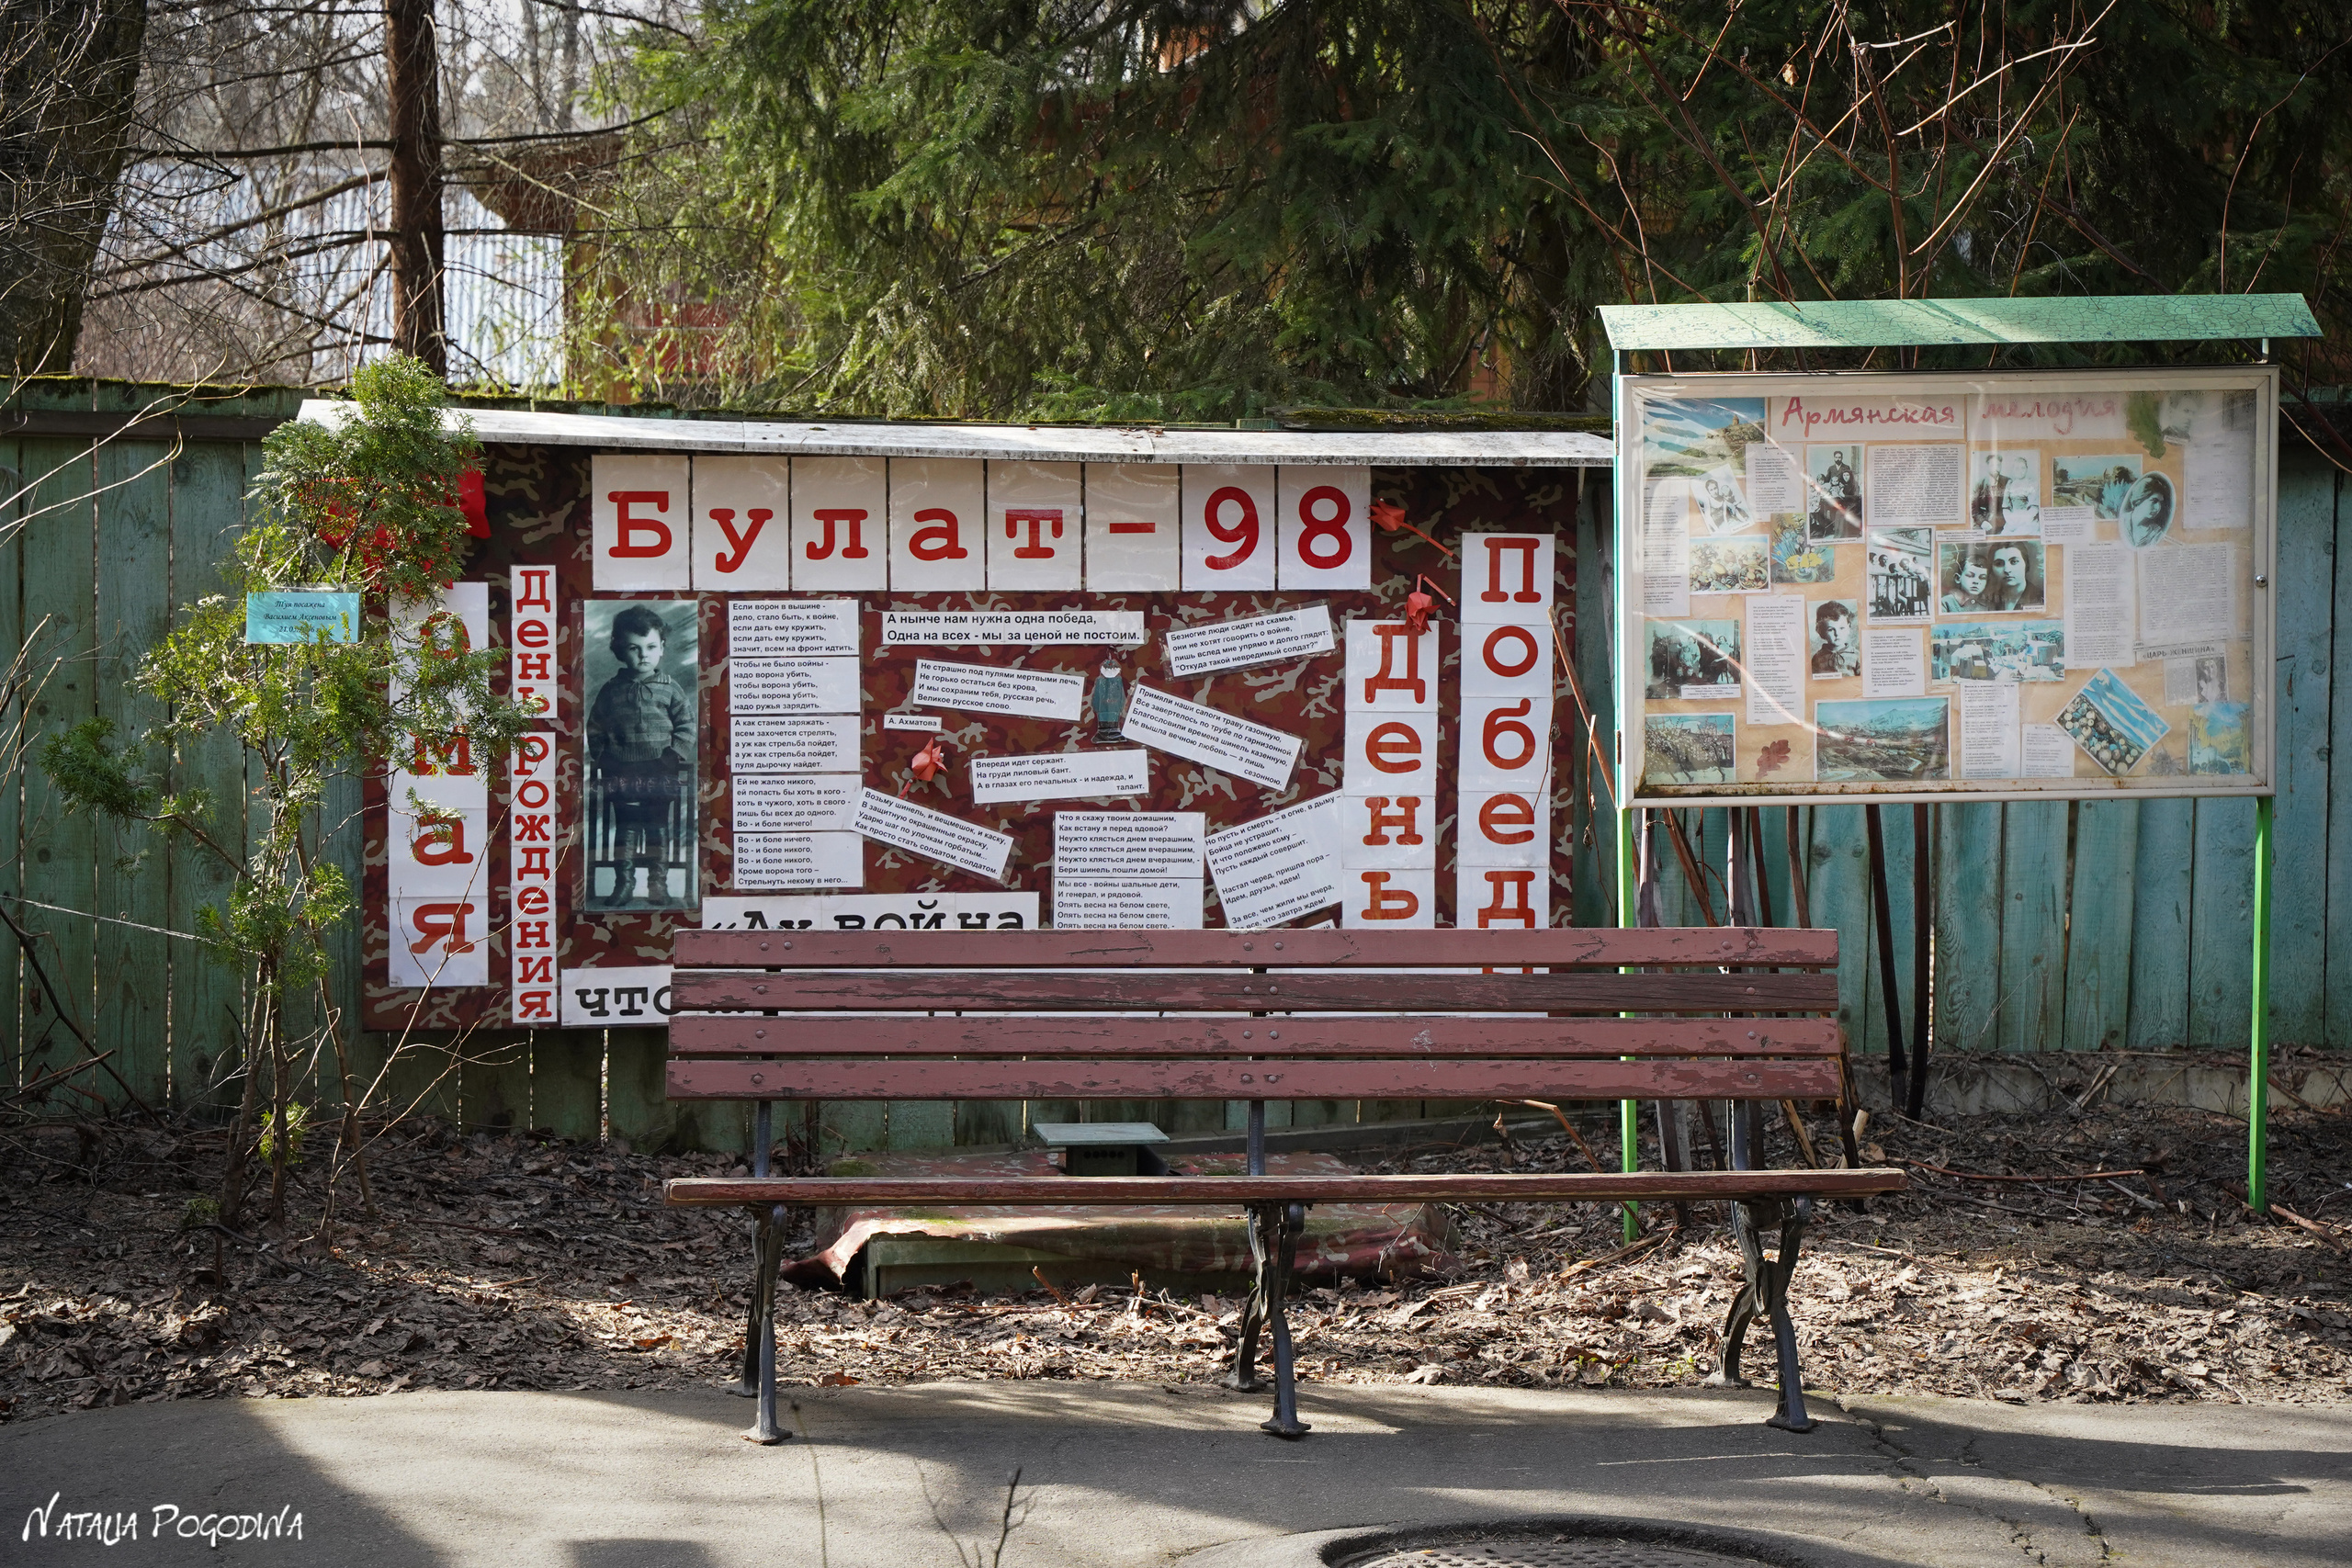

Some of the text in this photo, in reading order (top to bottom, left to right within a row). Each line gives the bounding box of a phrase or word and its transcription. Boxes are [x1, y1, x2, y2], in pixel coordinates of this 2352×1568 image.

[1781, 396, 2117, 437] Армянская мелодия
[275, 600, 292, 609] Туя
[887, 613, 897, 623] А
[972, 616, 1011, 626] нужна
[1014, 615, 1045, 625] одна
[1048, 613, 1096, 625] победа,
[1170, 630, 1206, 641] Безногие
[1208, 627, 1230, 635] люди
[1231, 622, 1253, 631] сидят
[1266, 615, 1296, 625] скамье,
[887, 630, 920, 642] Одна
[924, 632, 938, 640] на
[942, 632, 971, 640] всех
[982, 632, 1002, 642] мы
[1007, 632, 1021, 640] за
[1025, 631, 1062, 642] ценой
[1066, 632, 1080, 640] не
[1084, 632, 1140, 642] постоим.
[1199, 638, 1221, 647] хотят
[1222, 632, 1258, 643] говорить
[1266, 626, 1292, 635] войне,
[797, 645, 823, 653] фронт
[1197, 649, 1221, 658] вслед
[1238, 641, 1268, 652] упрямо
[1276, 635, 1299, 645] долго
[1300, 630, 1329, 640] глядят:
[1208, 657, 1230, 666] такой
[1232, 648, 1281, 662] невредимый
[786, 670, 812, 679] убить,
[933, 665, 967, 674] страшно
[1016, 674, 1057, 683] мертвыми
[792, 681, 818, 690] убить,
[960, 678, 996, 687] остаться
[1012, 684, 1037, 692] крова,
[917, 693, 951, 703] Великое
[952, 698, 984, 707] русское
[941, 687, 979, 696] сохраним
[981, 690, 1001, 699] тебя,
[1003, 693, 1034, 702] русская
[898, 718, 937, 726] Ахматова
[1139, 687, 1281, 743] Примяли наши сапоги траву газонную,
[1031, 758, 1066, 766] сержант.
[1477, 537, 1543, 974] Побед
[1013, 768, 1049, 777] лиловый
[1361, 625, 1426, 920] День
[514, 570, 553, 1018] День рождения
[865, 791, 894, 807] Возьму
[895, 803, 926, 818] шинель,
[934, 816, 975, 835] вещмешок,
[984, 833, 1006, 845] каску,
[1106, 813, 1131, 822] твоим
[409, 726, 477, 953] мая
[1058, 866, 1078, 874] Бери
[738, 878, 785, 886] Стрельнуть
[1225, 873, 1301, 905] Идем, друзья, идем!
